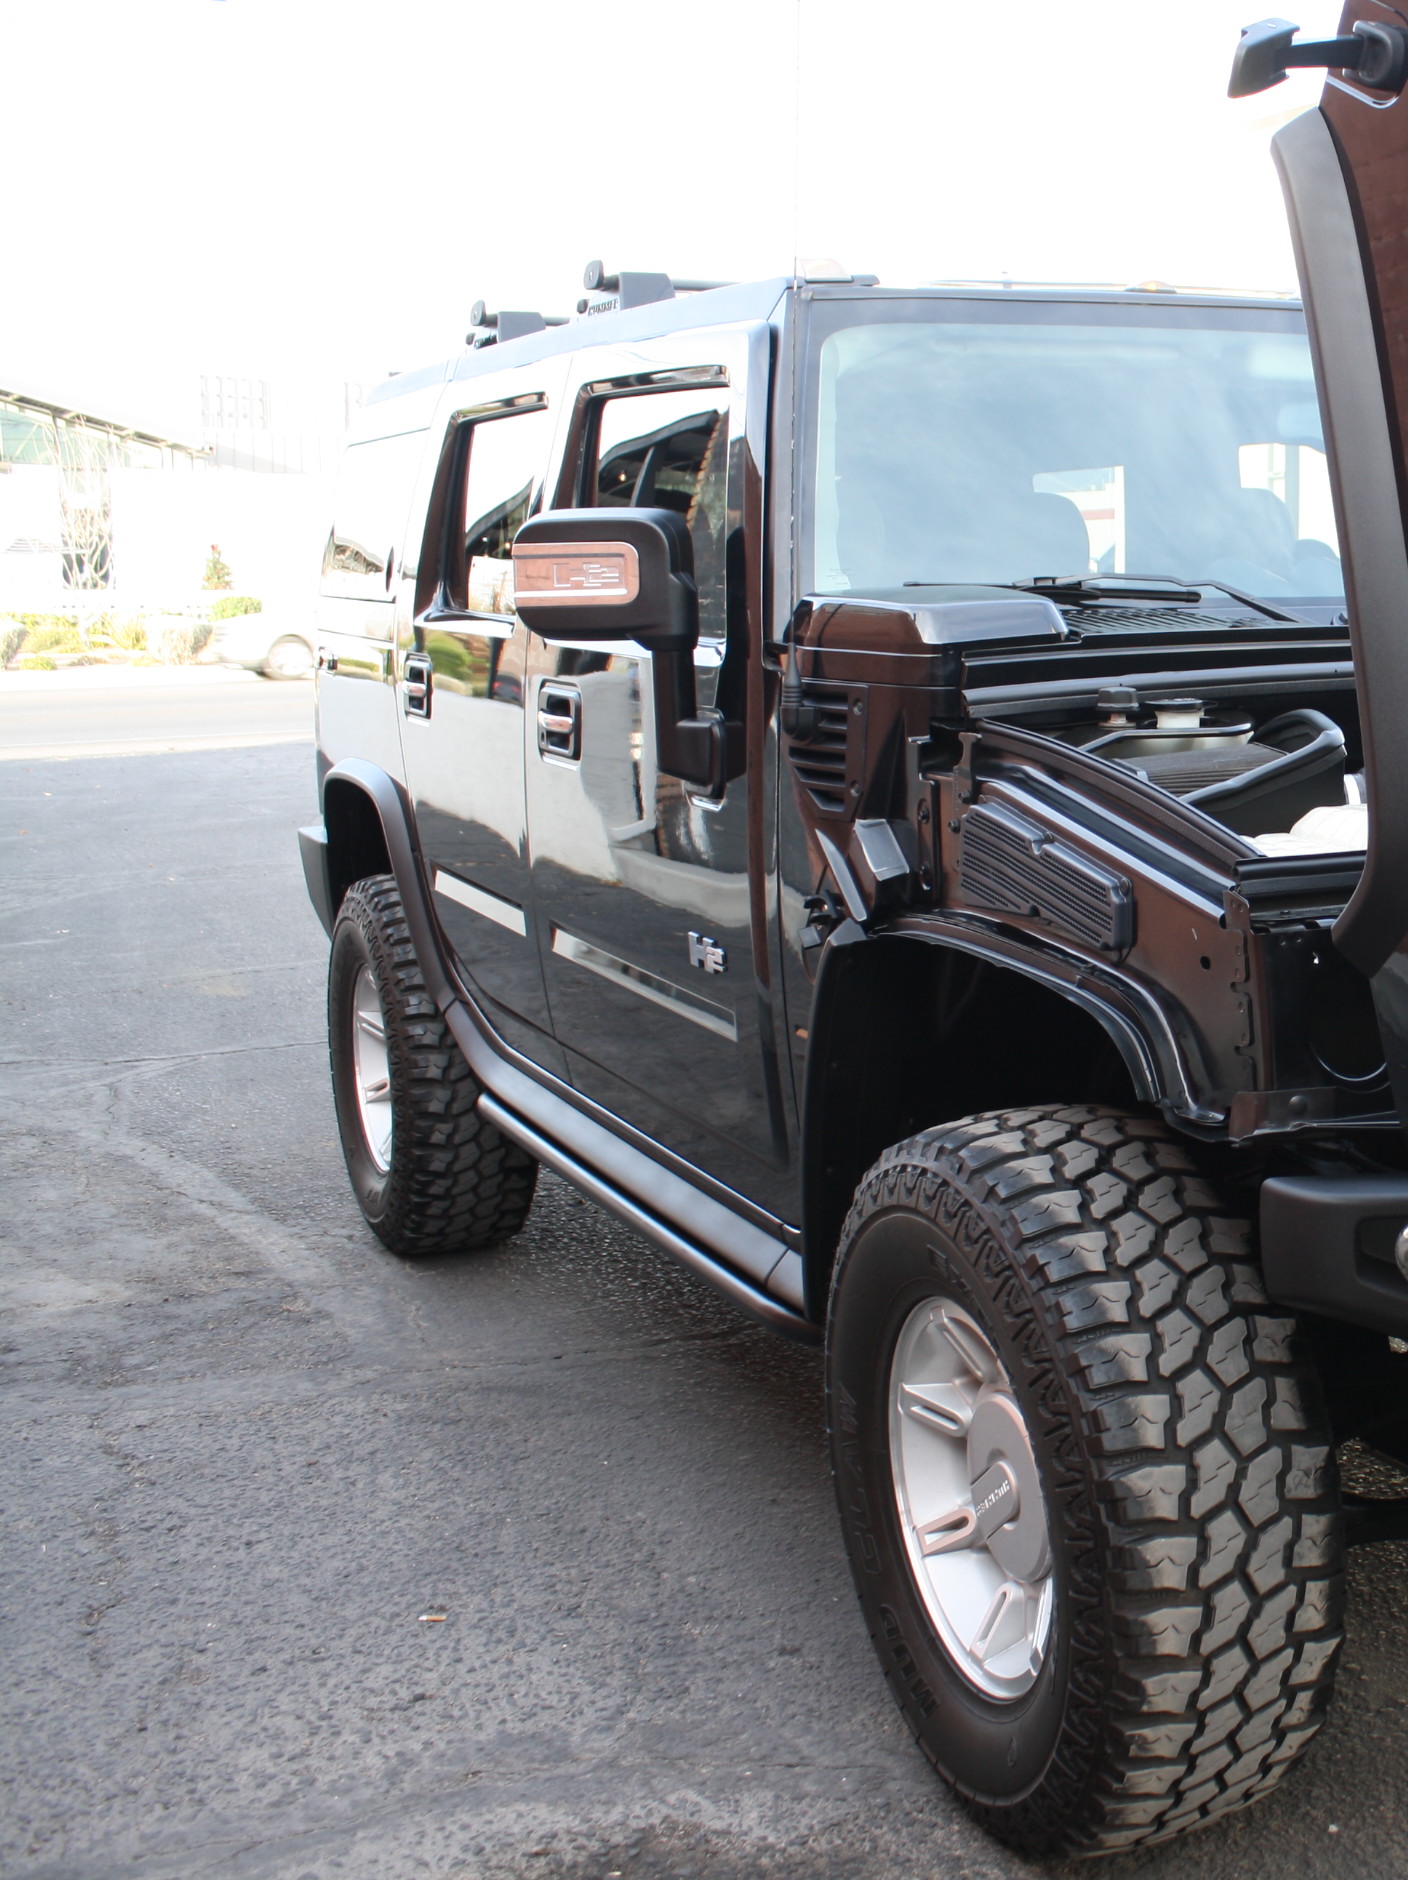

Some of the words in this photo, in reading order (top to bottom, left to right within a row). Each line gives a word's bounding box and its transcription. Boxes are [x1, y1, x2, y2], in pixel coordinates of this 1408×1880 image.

[553, 561, 620, 588] H2
[688, 931, 728, 974] H2
[879, 1603, 940, 1719] MUD
